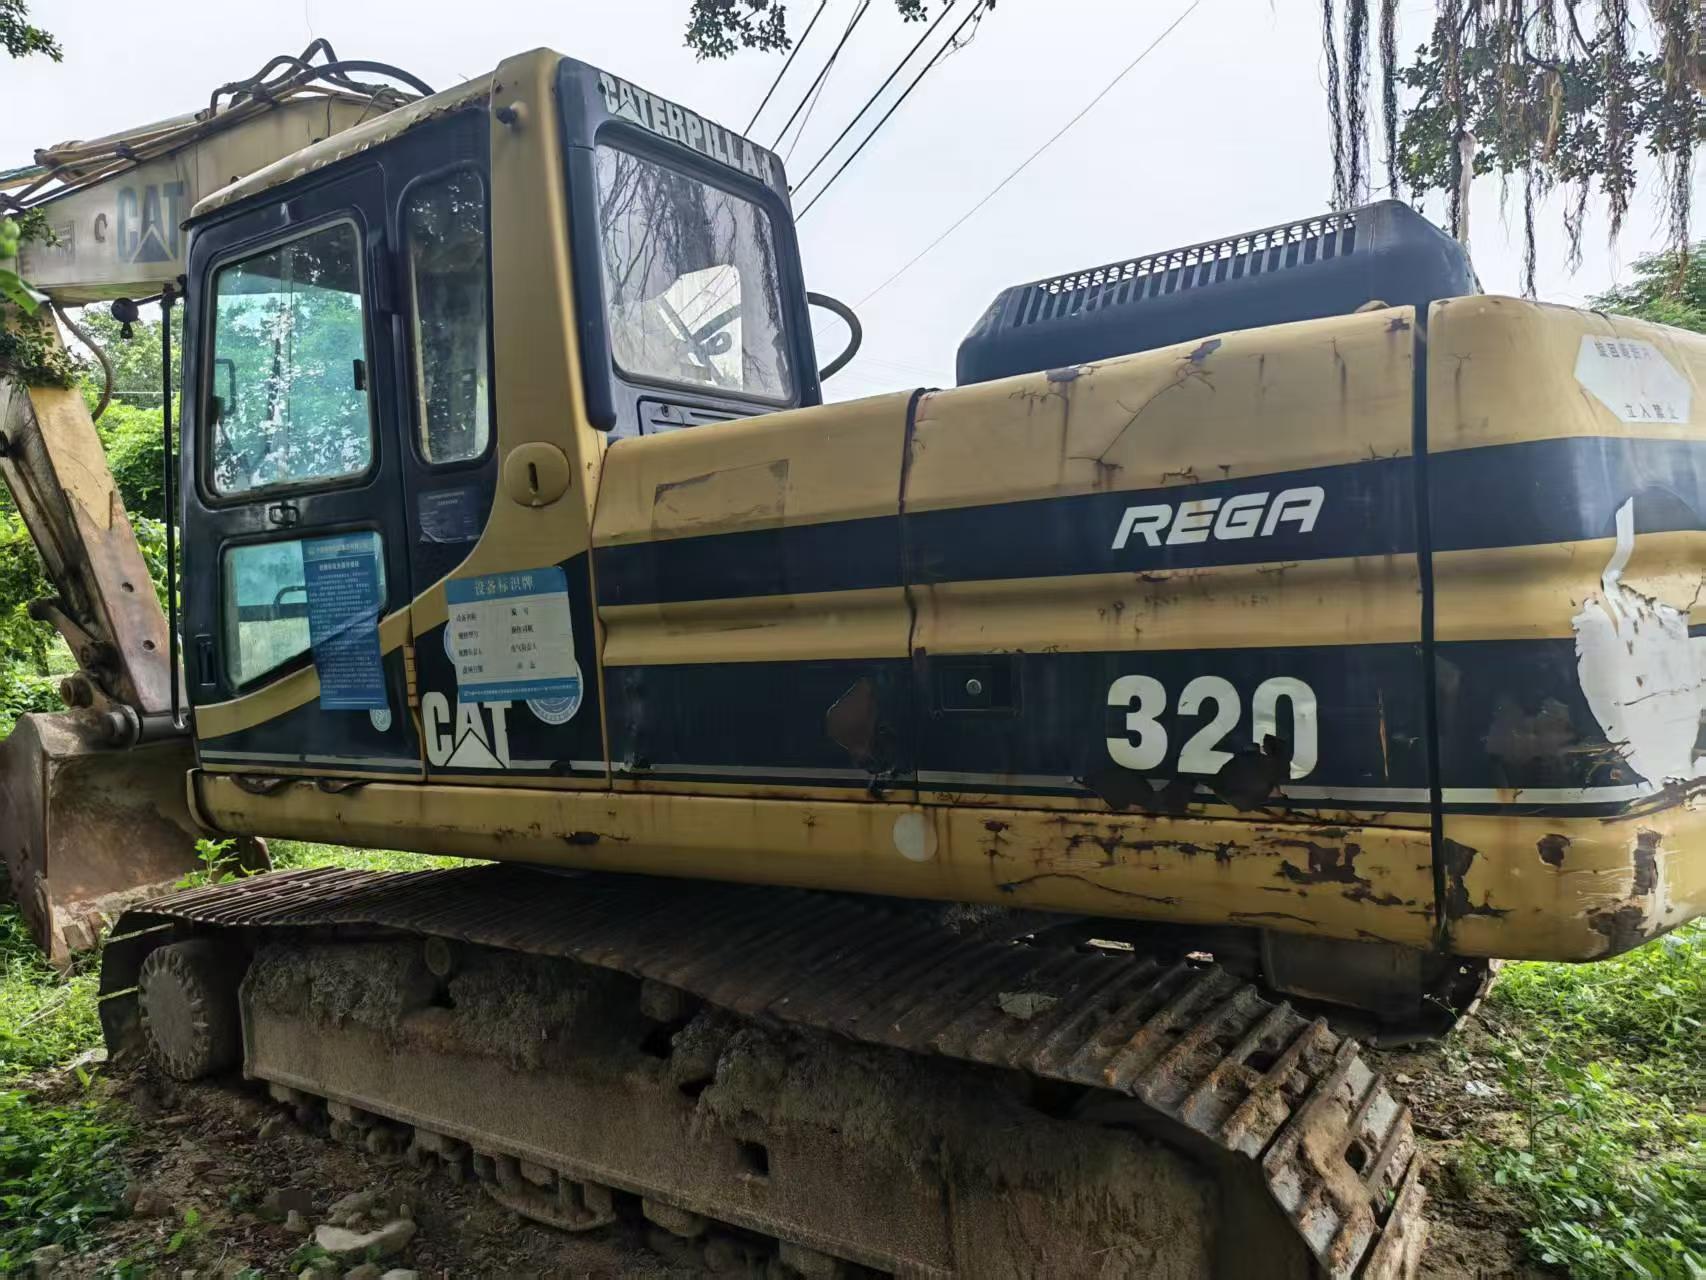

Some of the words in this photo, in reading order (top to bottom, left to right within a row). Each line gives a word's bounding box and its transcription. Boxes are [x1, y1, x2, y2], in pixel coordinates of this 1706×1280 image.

[116, 181, 184, 264] CAT
[1111, 486, 1325, 550] REGA
[474, 575, 534, 596] 设备标识牌
[422, 691, 513, 769] CAT
[1106, 674, 1318, 780] 320
